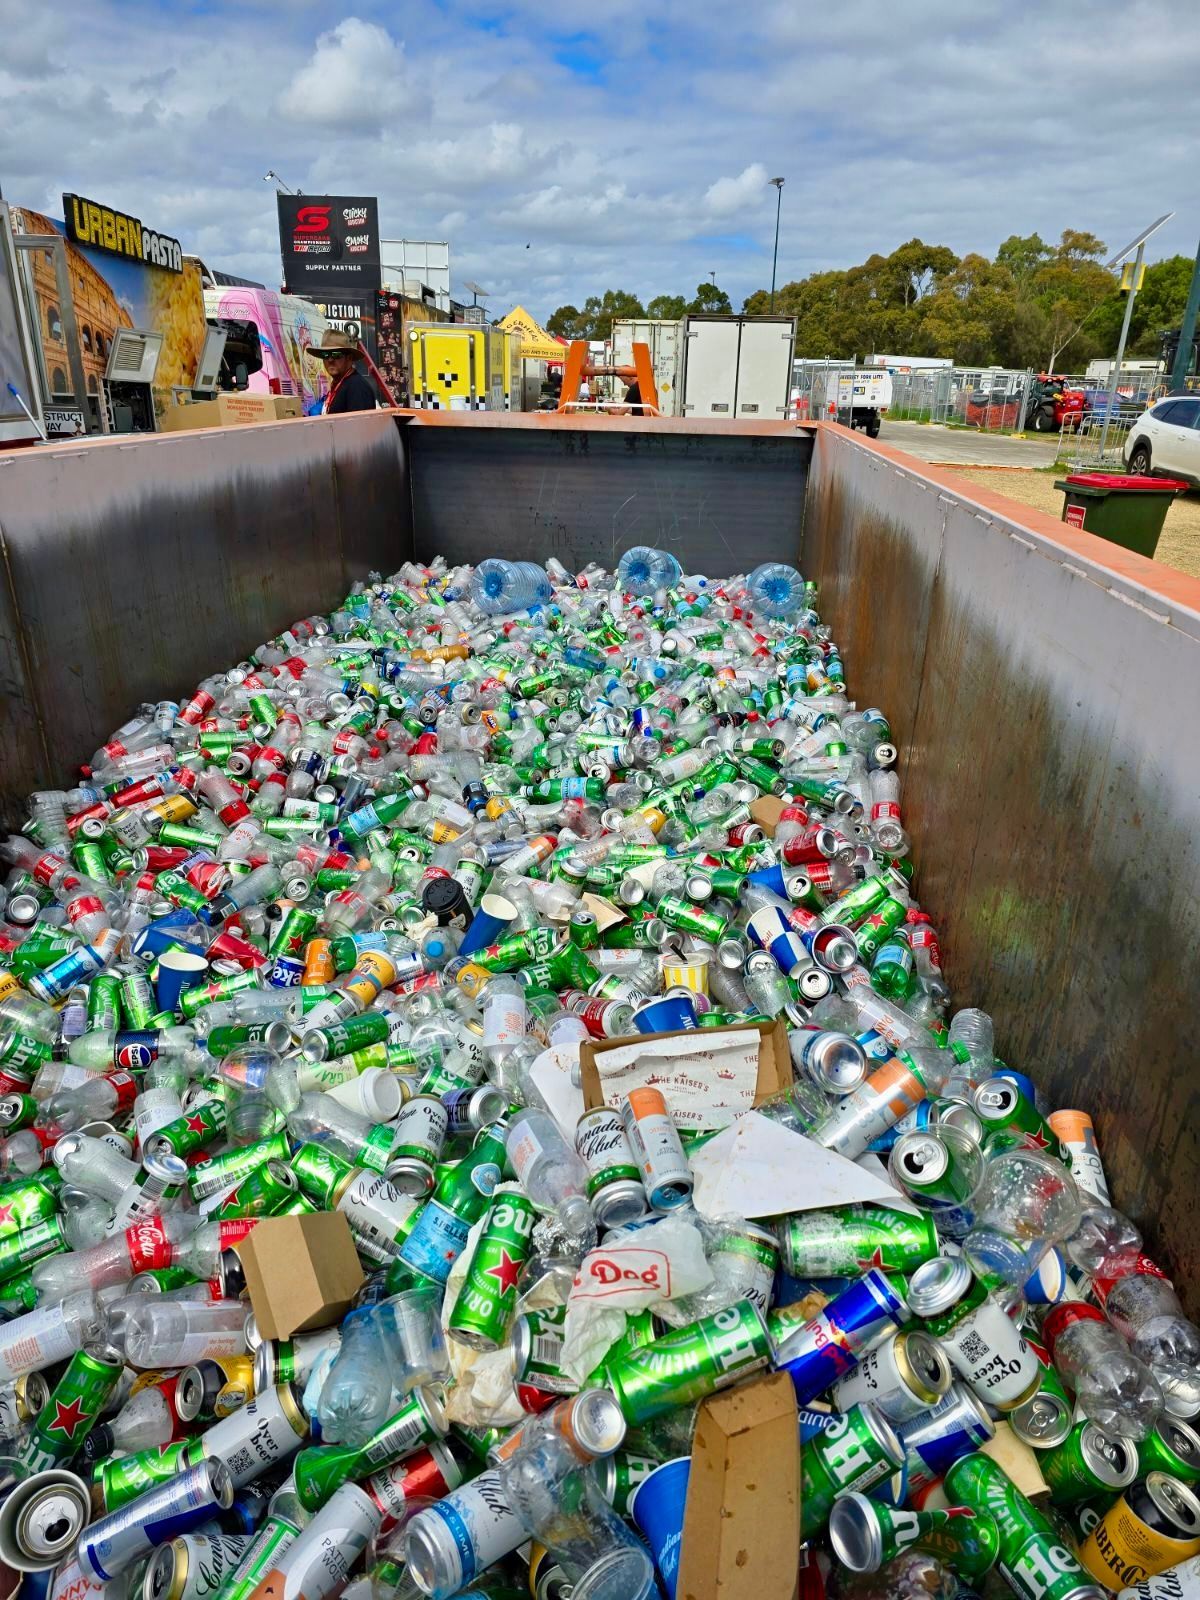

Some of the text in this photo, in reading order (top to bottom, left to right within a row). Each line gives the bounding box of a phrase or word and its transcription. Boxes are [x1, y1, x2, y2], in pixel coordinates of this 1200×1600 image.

[72, 197, 182, 272] URBAN PASTA
[674, 1077, 710, 1093] KAISER'S
[593, 1167, 625, 1184] DRY
[713, 1306, 758, 1371] He
[985, 1357, 1022, 1389] Over
[256, 1417, 280, 1452] Over
[822, 1412, 874, 1484] He
[455, 1525, 470, 1559] LIME
[1013, 1542, 1082, 1600] He
